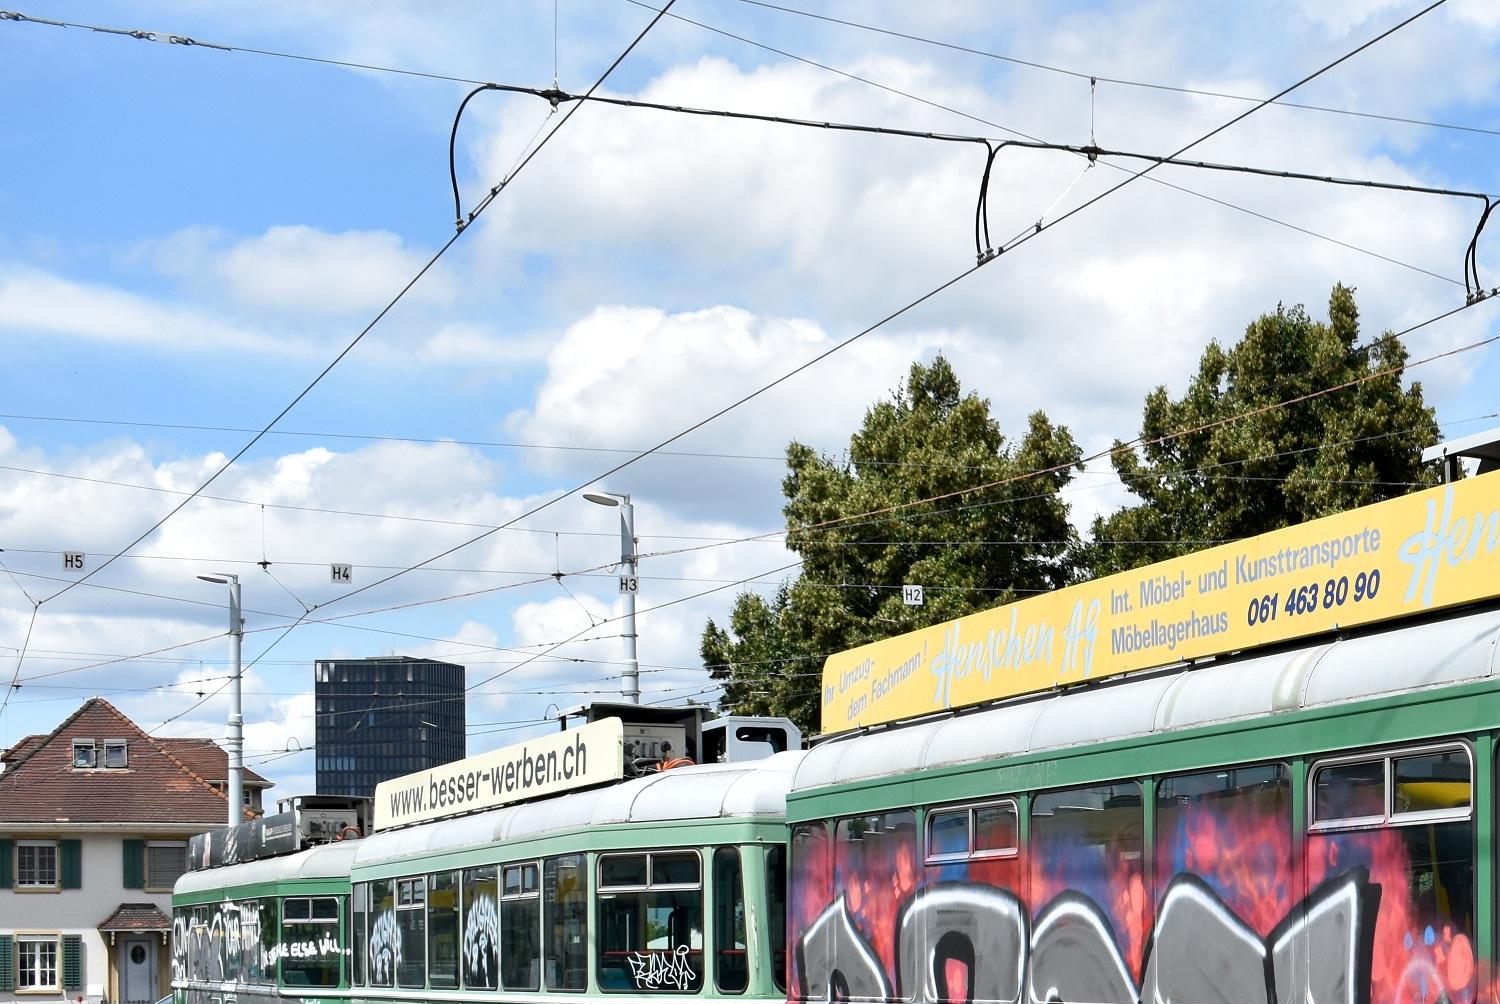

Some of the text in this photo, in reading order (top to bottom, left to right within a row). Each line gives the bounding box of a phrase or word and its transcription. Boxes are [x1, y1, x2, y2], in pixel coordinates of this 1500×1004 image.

[65, 554, 83, 569] H5
[332, 565, 349, 580] H4
[1110, 526, 1381, 616] Int. Möbel- und Kunsttransporte
[620, 578, 637, 591] H3
[905, 589, 920, 601] H2
[1247, 568, 1381, 627] 061 463 80 90
[1111, 610, 1229, 655] Möbellagerhaus
[930, 607, 1055, 708] Henschen
[823, 656, 875, 706] Ihr Umzug-
[847, 694, 867, 721] dem
[390, 732, 586, 818] www.besser-werben.ch
